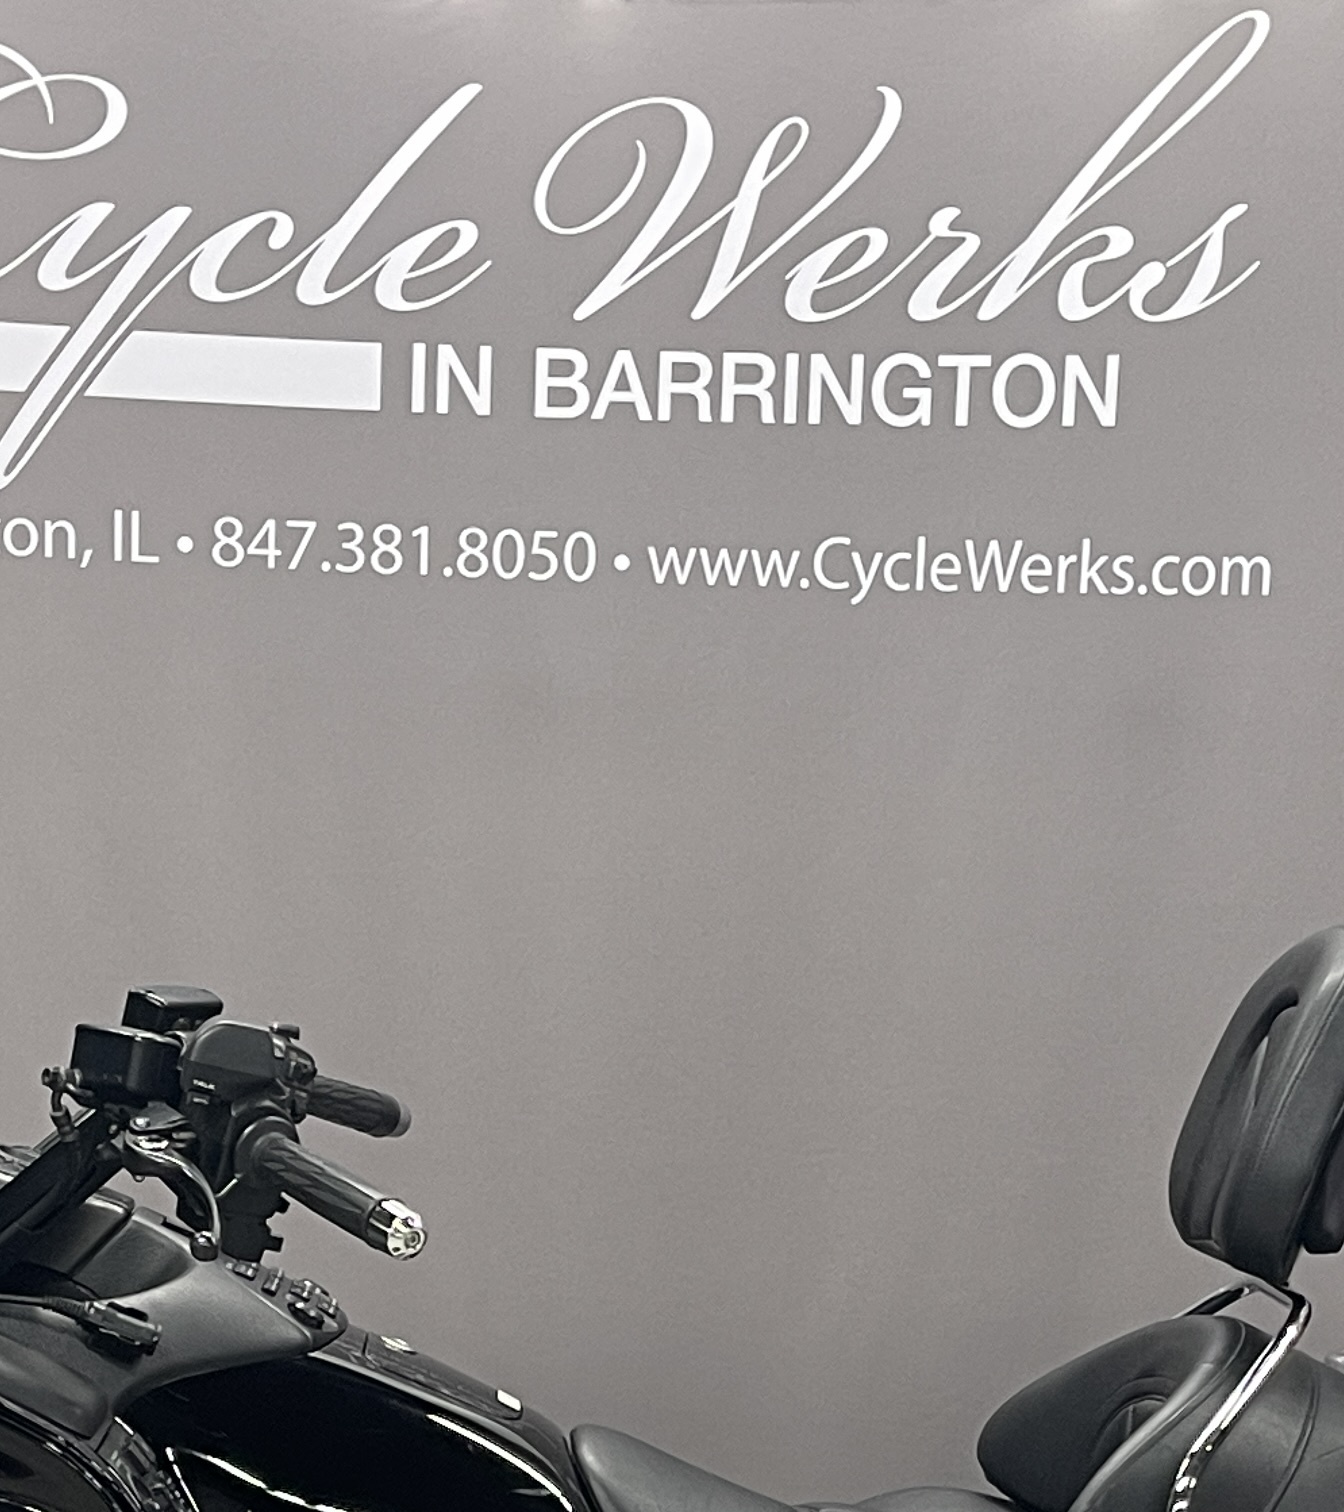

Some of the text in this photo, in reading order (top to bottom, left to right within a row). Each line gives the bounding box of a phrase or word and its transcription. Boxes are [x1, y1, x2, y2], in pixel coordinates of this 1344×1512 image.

[532, 8, 1271, 323] Werks
[411, 342, 1120, 429] IN BARRINGTON
[113, 509, 160, 563] IL
[211, 516, 597, 582] 847.381.8050
[647, 535, 1272, 605] www.CycleWerks.com
